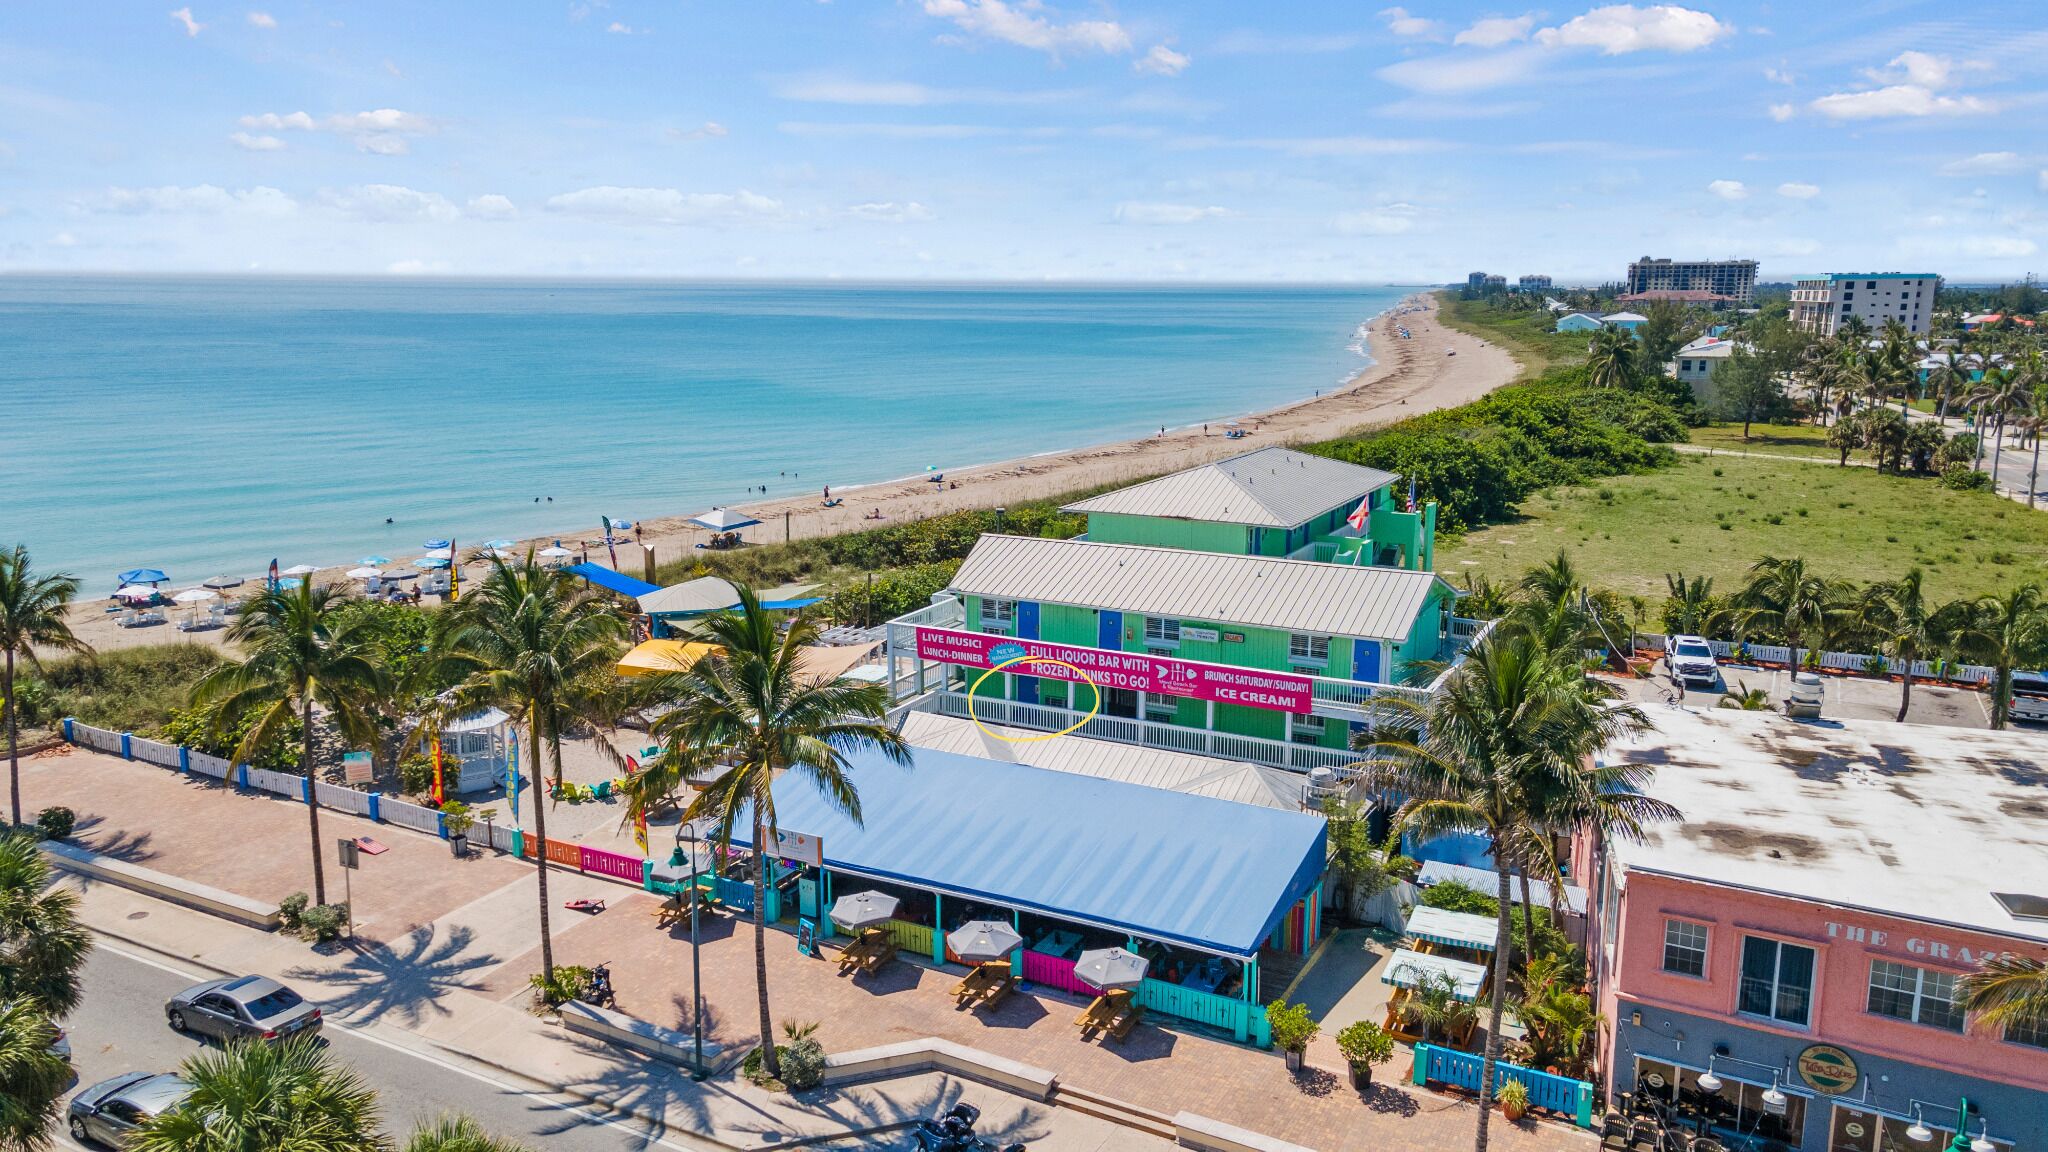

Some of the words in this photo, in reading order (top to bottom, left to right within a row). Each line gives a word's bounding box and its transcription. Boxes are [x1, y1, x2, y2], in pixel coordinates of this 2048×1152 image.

[922, 632, 945, 644] LIVE
[946, 636, 982, 648] MUSIC!
[923, 646, 984, 664] LUNCH-DINNER
[1030, 646, 1054, 660] FULL
[1056, 648, 1096, 664] LIQUOR
[1098, 654, 1120, 668] BAR
[1122, 656, 1150, 672] WITH
[1031, 661, 1070, 678] FROZEN
[1072, 668, 1110, 684] DRINKS
[1112, 672, 1126, 686] TO
[1129, 675, 1150, 689] GO!
[1204, 670, 1234, 683] BRUNCH
[1235, 674, 1308, 693] SATURDAY/SUNDAY!
[1216, 687, 1237, 699] ICE
[1240, 692, 1296, 707] CREAM!
[1824, 922, 1888, 946] THE
